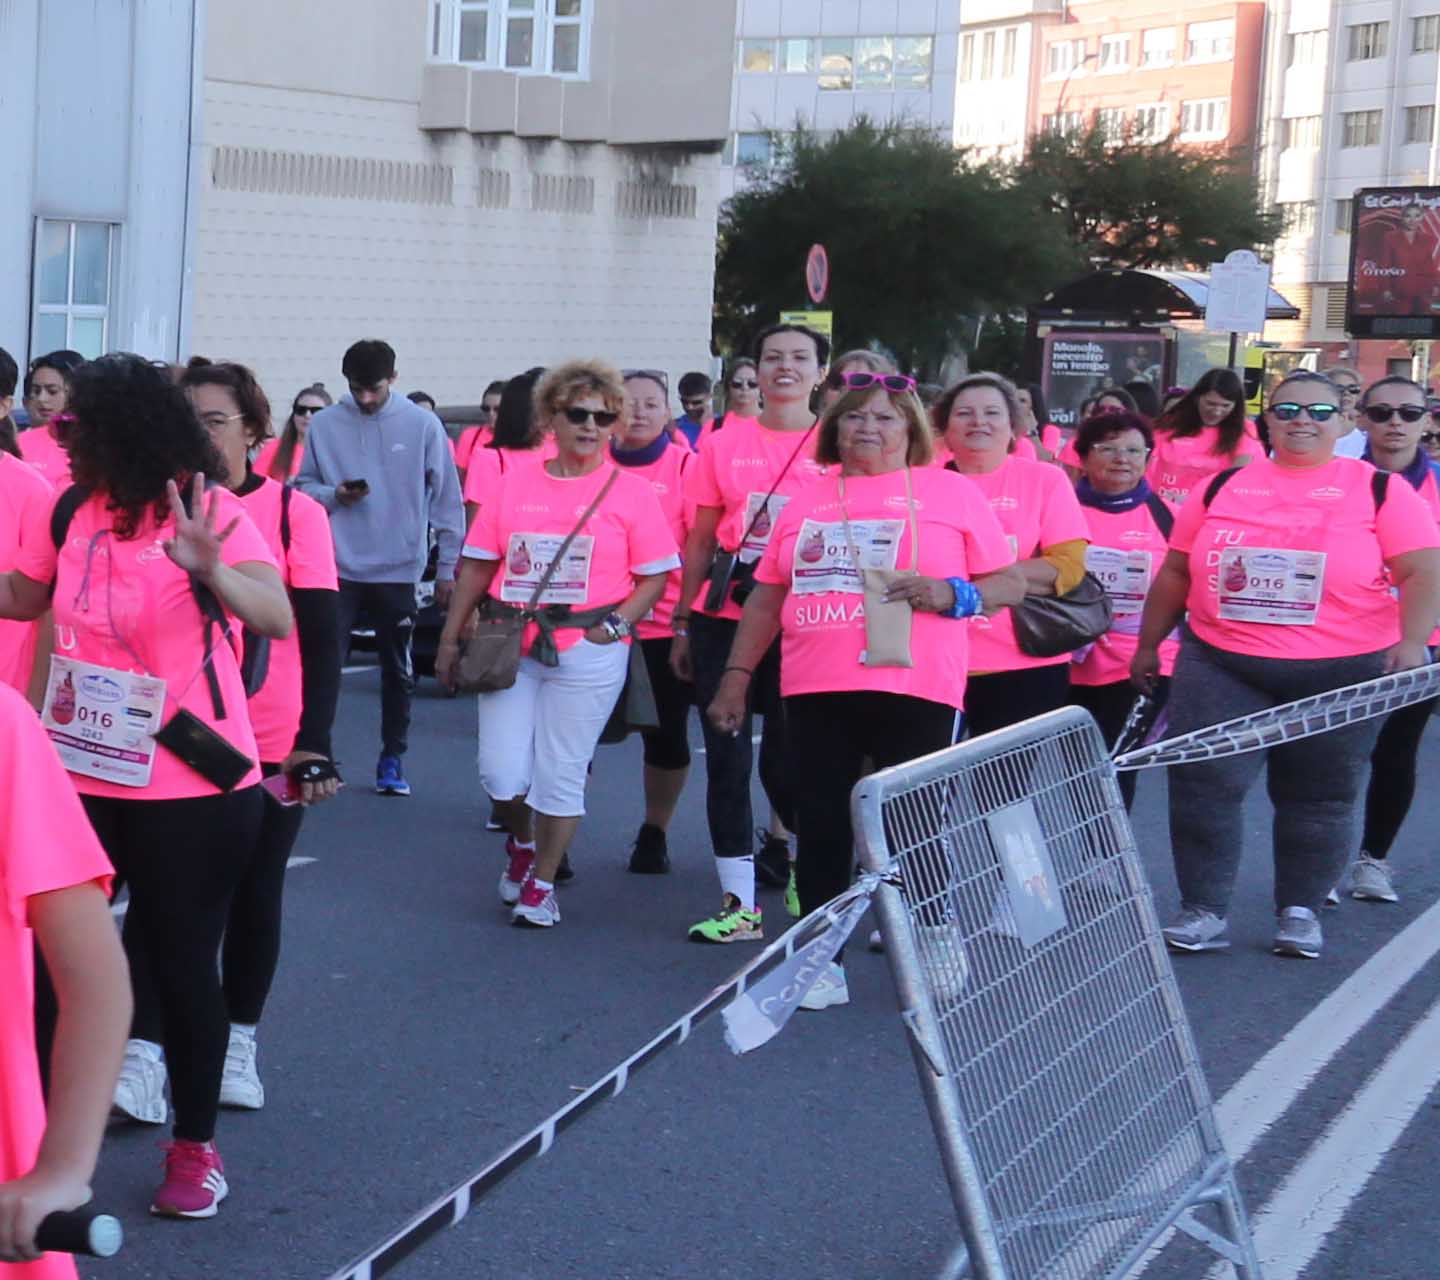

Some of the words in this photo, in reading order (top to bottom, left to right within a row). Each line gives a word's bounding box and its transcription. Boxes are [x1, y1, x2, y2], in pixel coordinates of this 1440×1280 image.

[1250, 576, 1284, 589] 016
[795, 603, 865, 627] SUMA
[78, 706, 113, 729] 016
